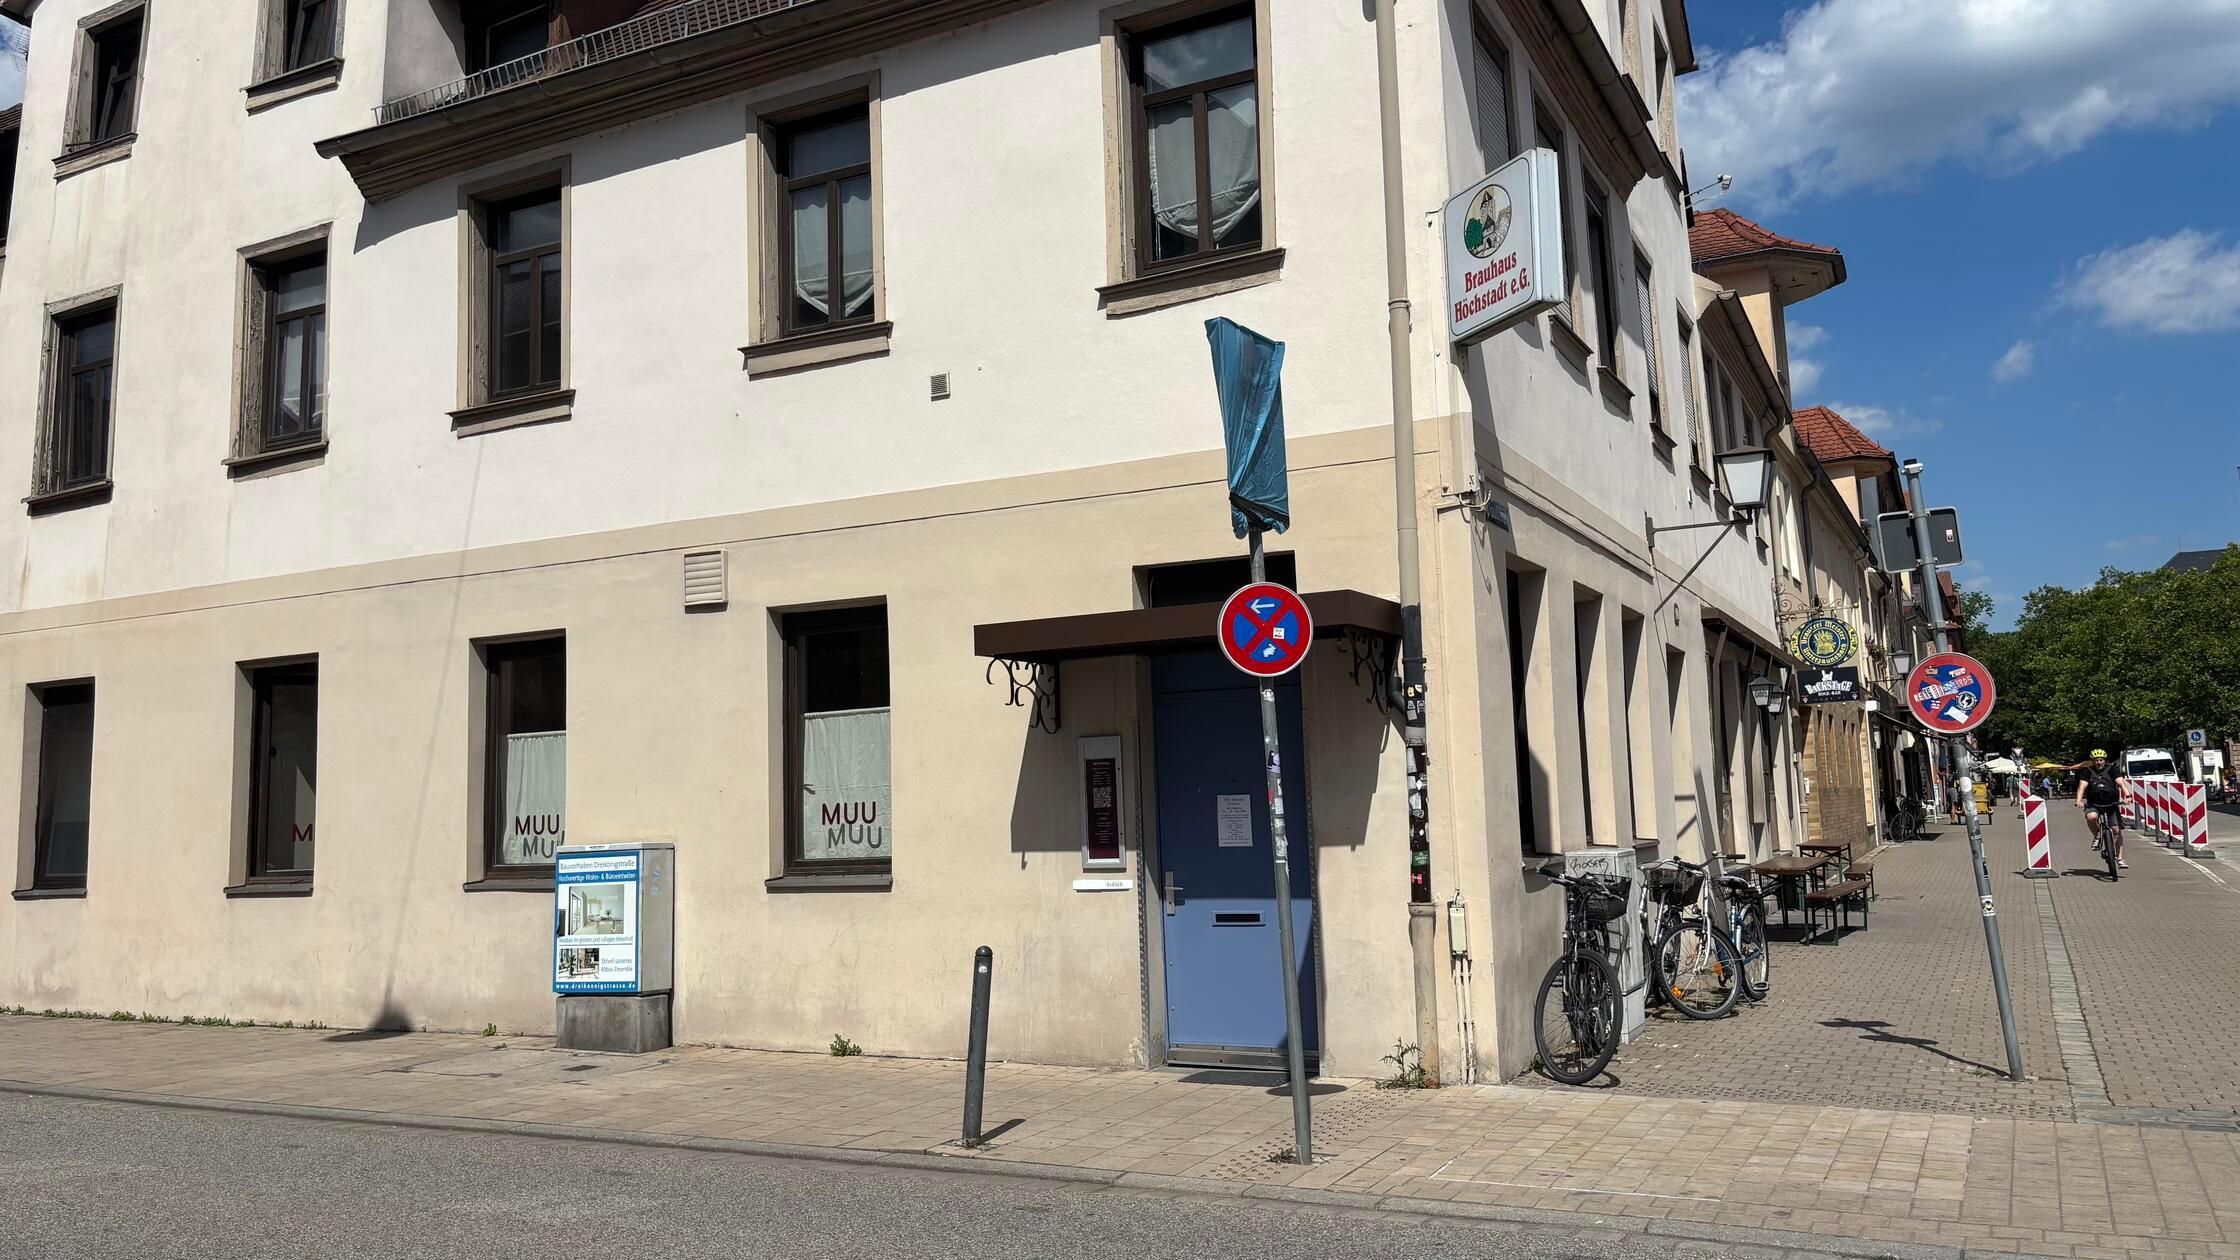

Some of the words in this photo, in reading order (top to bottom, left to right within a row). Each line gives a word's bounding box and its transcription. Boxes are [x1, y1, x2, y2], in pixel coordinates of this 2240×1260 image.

[1464, 251, 1517, 293] Brauhaus
[1454, 279, 1508, 323] Höchstadt
[1510, 267, 1530, 294] e.G.
[1804, 680, 1853, 695] BACKSTAGE
[822, 801, 876, 825] MUU
[515, 814, 559, 835] MUU
[560, 861, 594, 870] Bauvorhaben
[593, 859, 635, 870] Dreikönigstraße
[558, 873, 586, 883] Hochwertige
[600, 872, 605, 880] &
[555, 982, 636, 990] www.dreikoenigstrasse.de
